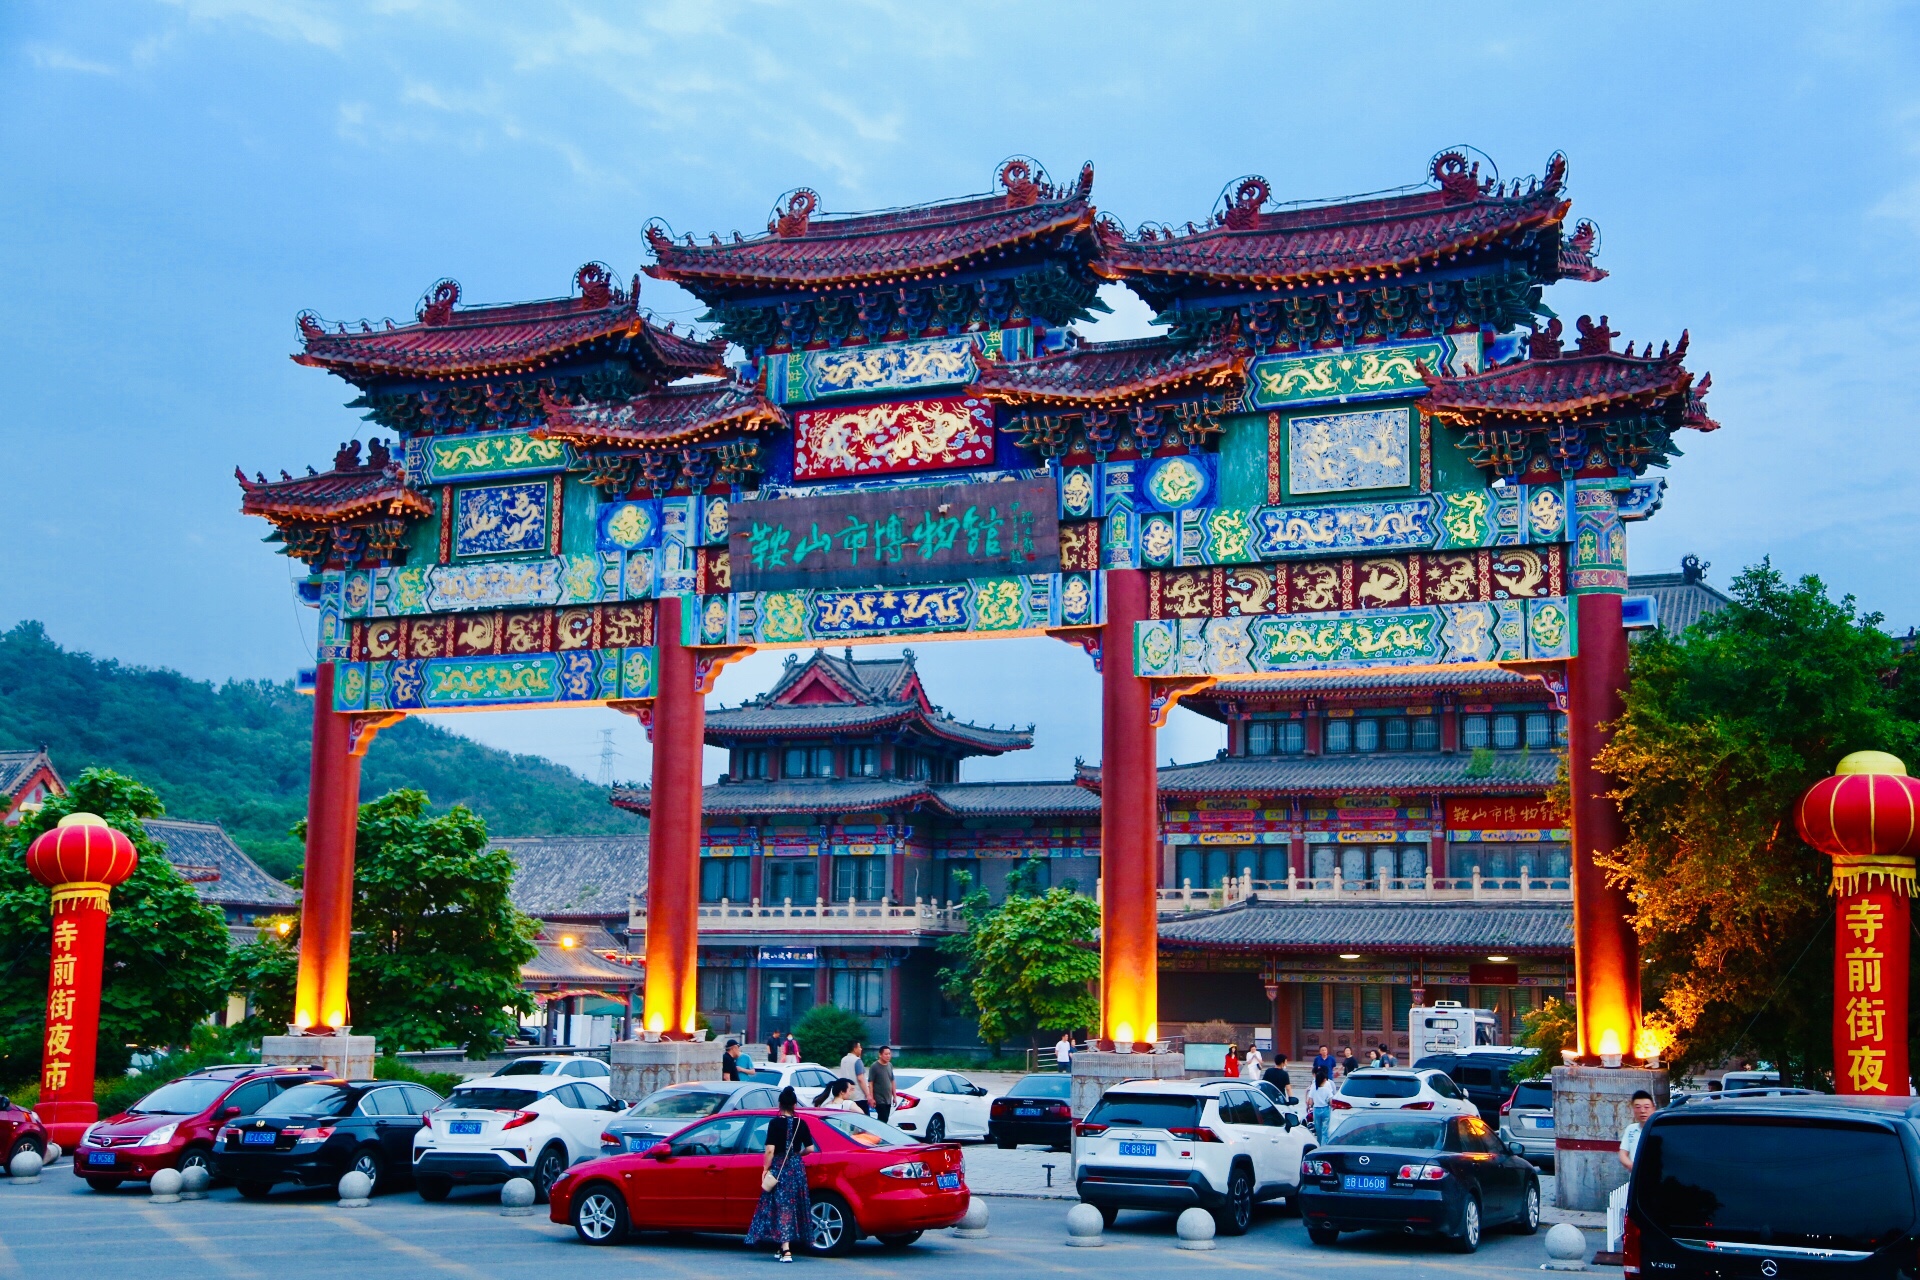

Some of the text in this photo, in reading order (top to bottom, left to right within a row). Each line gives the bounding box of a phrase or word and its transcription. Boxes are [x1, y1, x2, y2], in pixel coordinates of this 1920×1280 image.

[45, 920, 79, 1091] 寺前街夜市
[1845, 899, 1889, 1092] 寺前街夜
